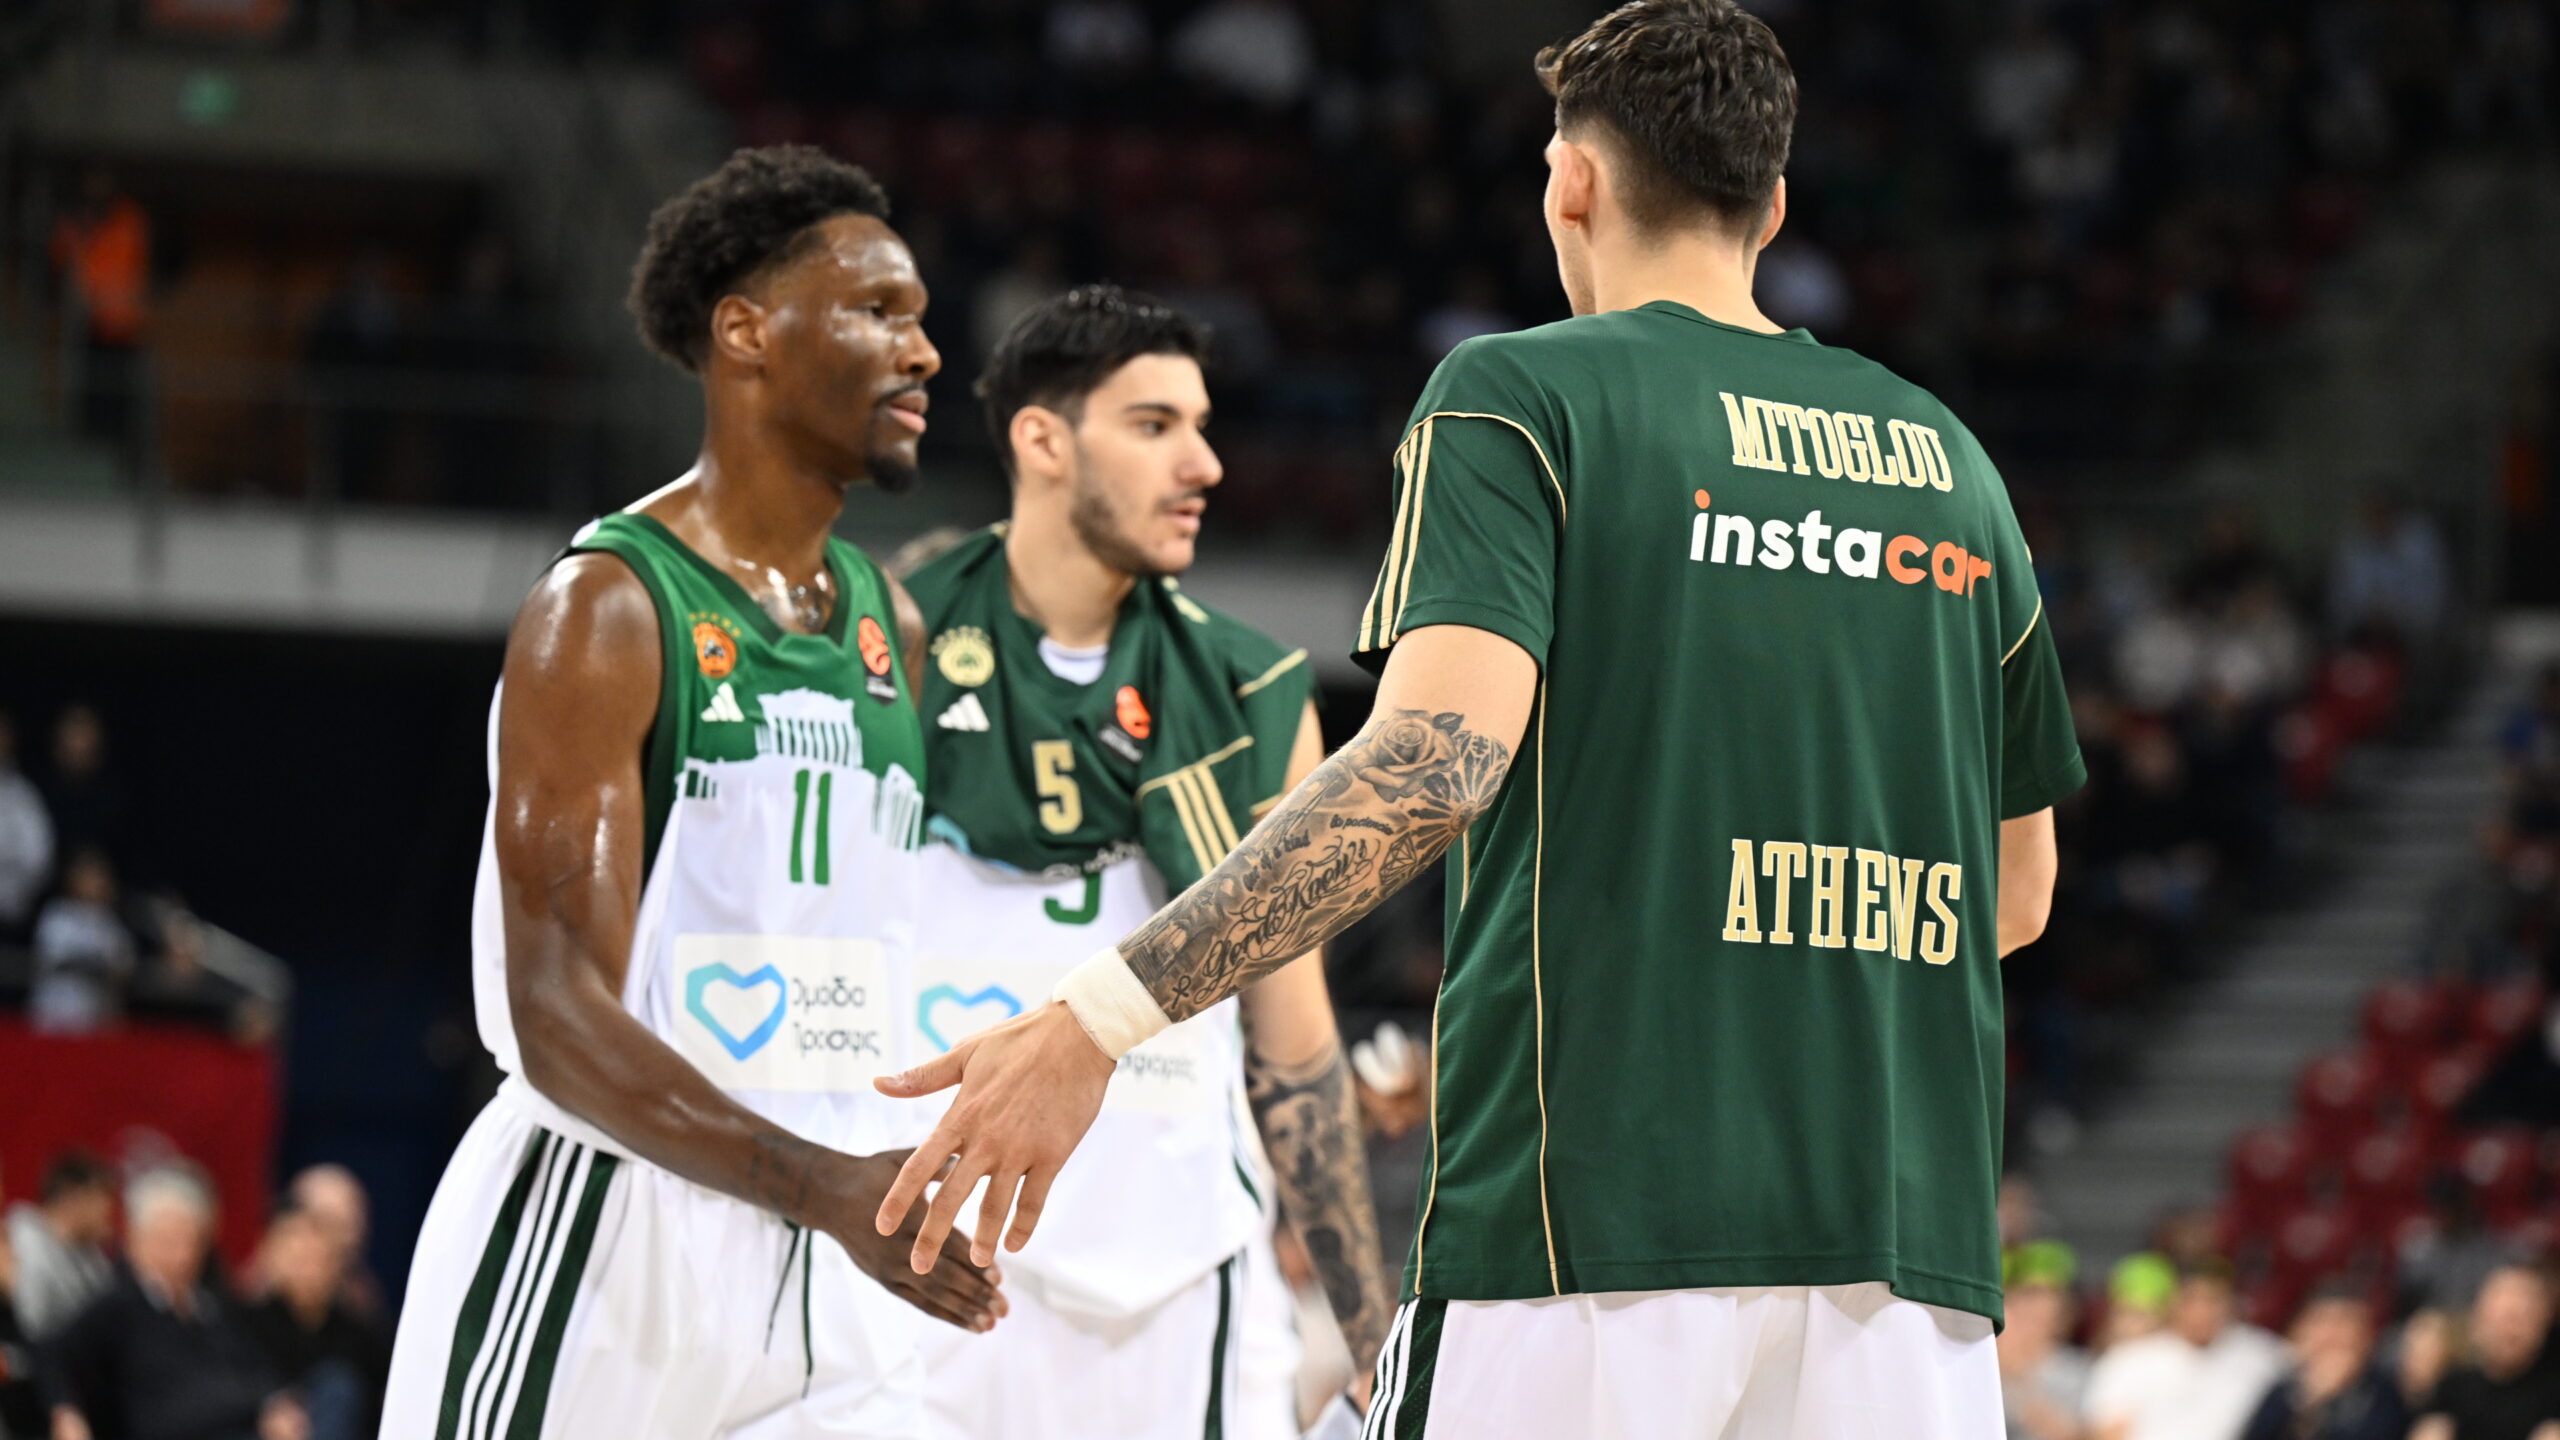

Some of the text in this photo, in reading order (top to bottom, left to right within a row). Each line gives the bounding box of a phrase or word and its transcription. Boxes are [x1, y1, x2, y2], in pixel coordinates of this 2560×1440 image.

[1718, 391, 1953, 492] MITOGLOU
[1690, 489, 1992, 600] instacar
[790, 769, 832, 886] 11
[1032, 740, 1083, 834] 5
[1722, 838, 1962, 965] ATHENS
